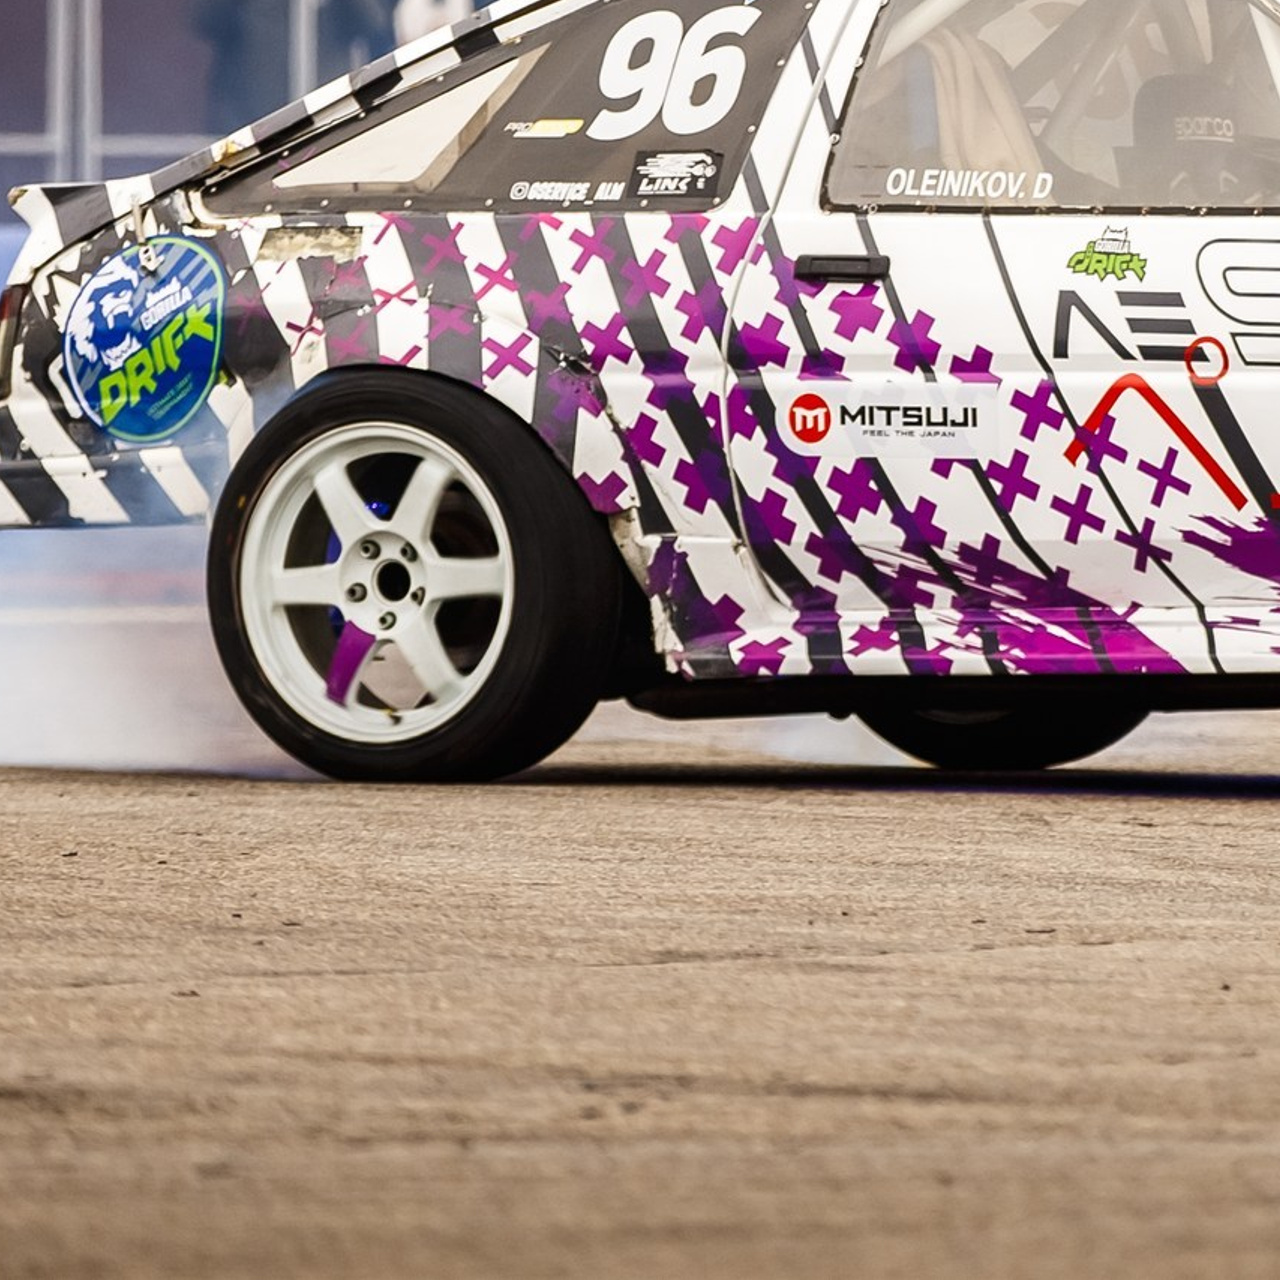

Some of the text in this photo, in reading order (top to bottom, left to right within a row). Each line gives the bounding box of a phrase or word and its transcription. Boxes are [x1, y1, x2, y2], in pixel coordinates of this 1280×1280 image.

[585, 5, 763, 141] 96
[886, 168, 1054, 199] OLEINIKOV. D
[840, 405, 978, 428] MITSUJI
